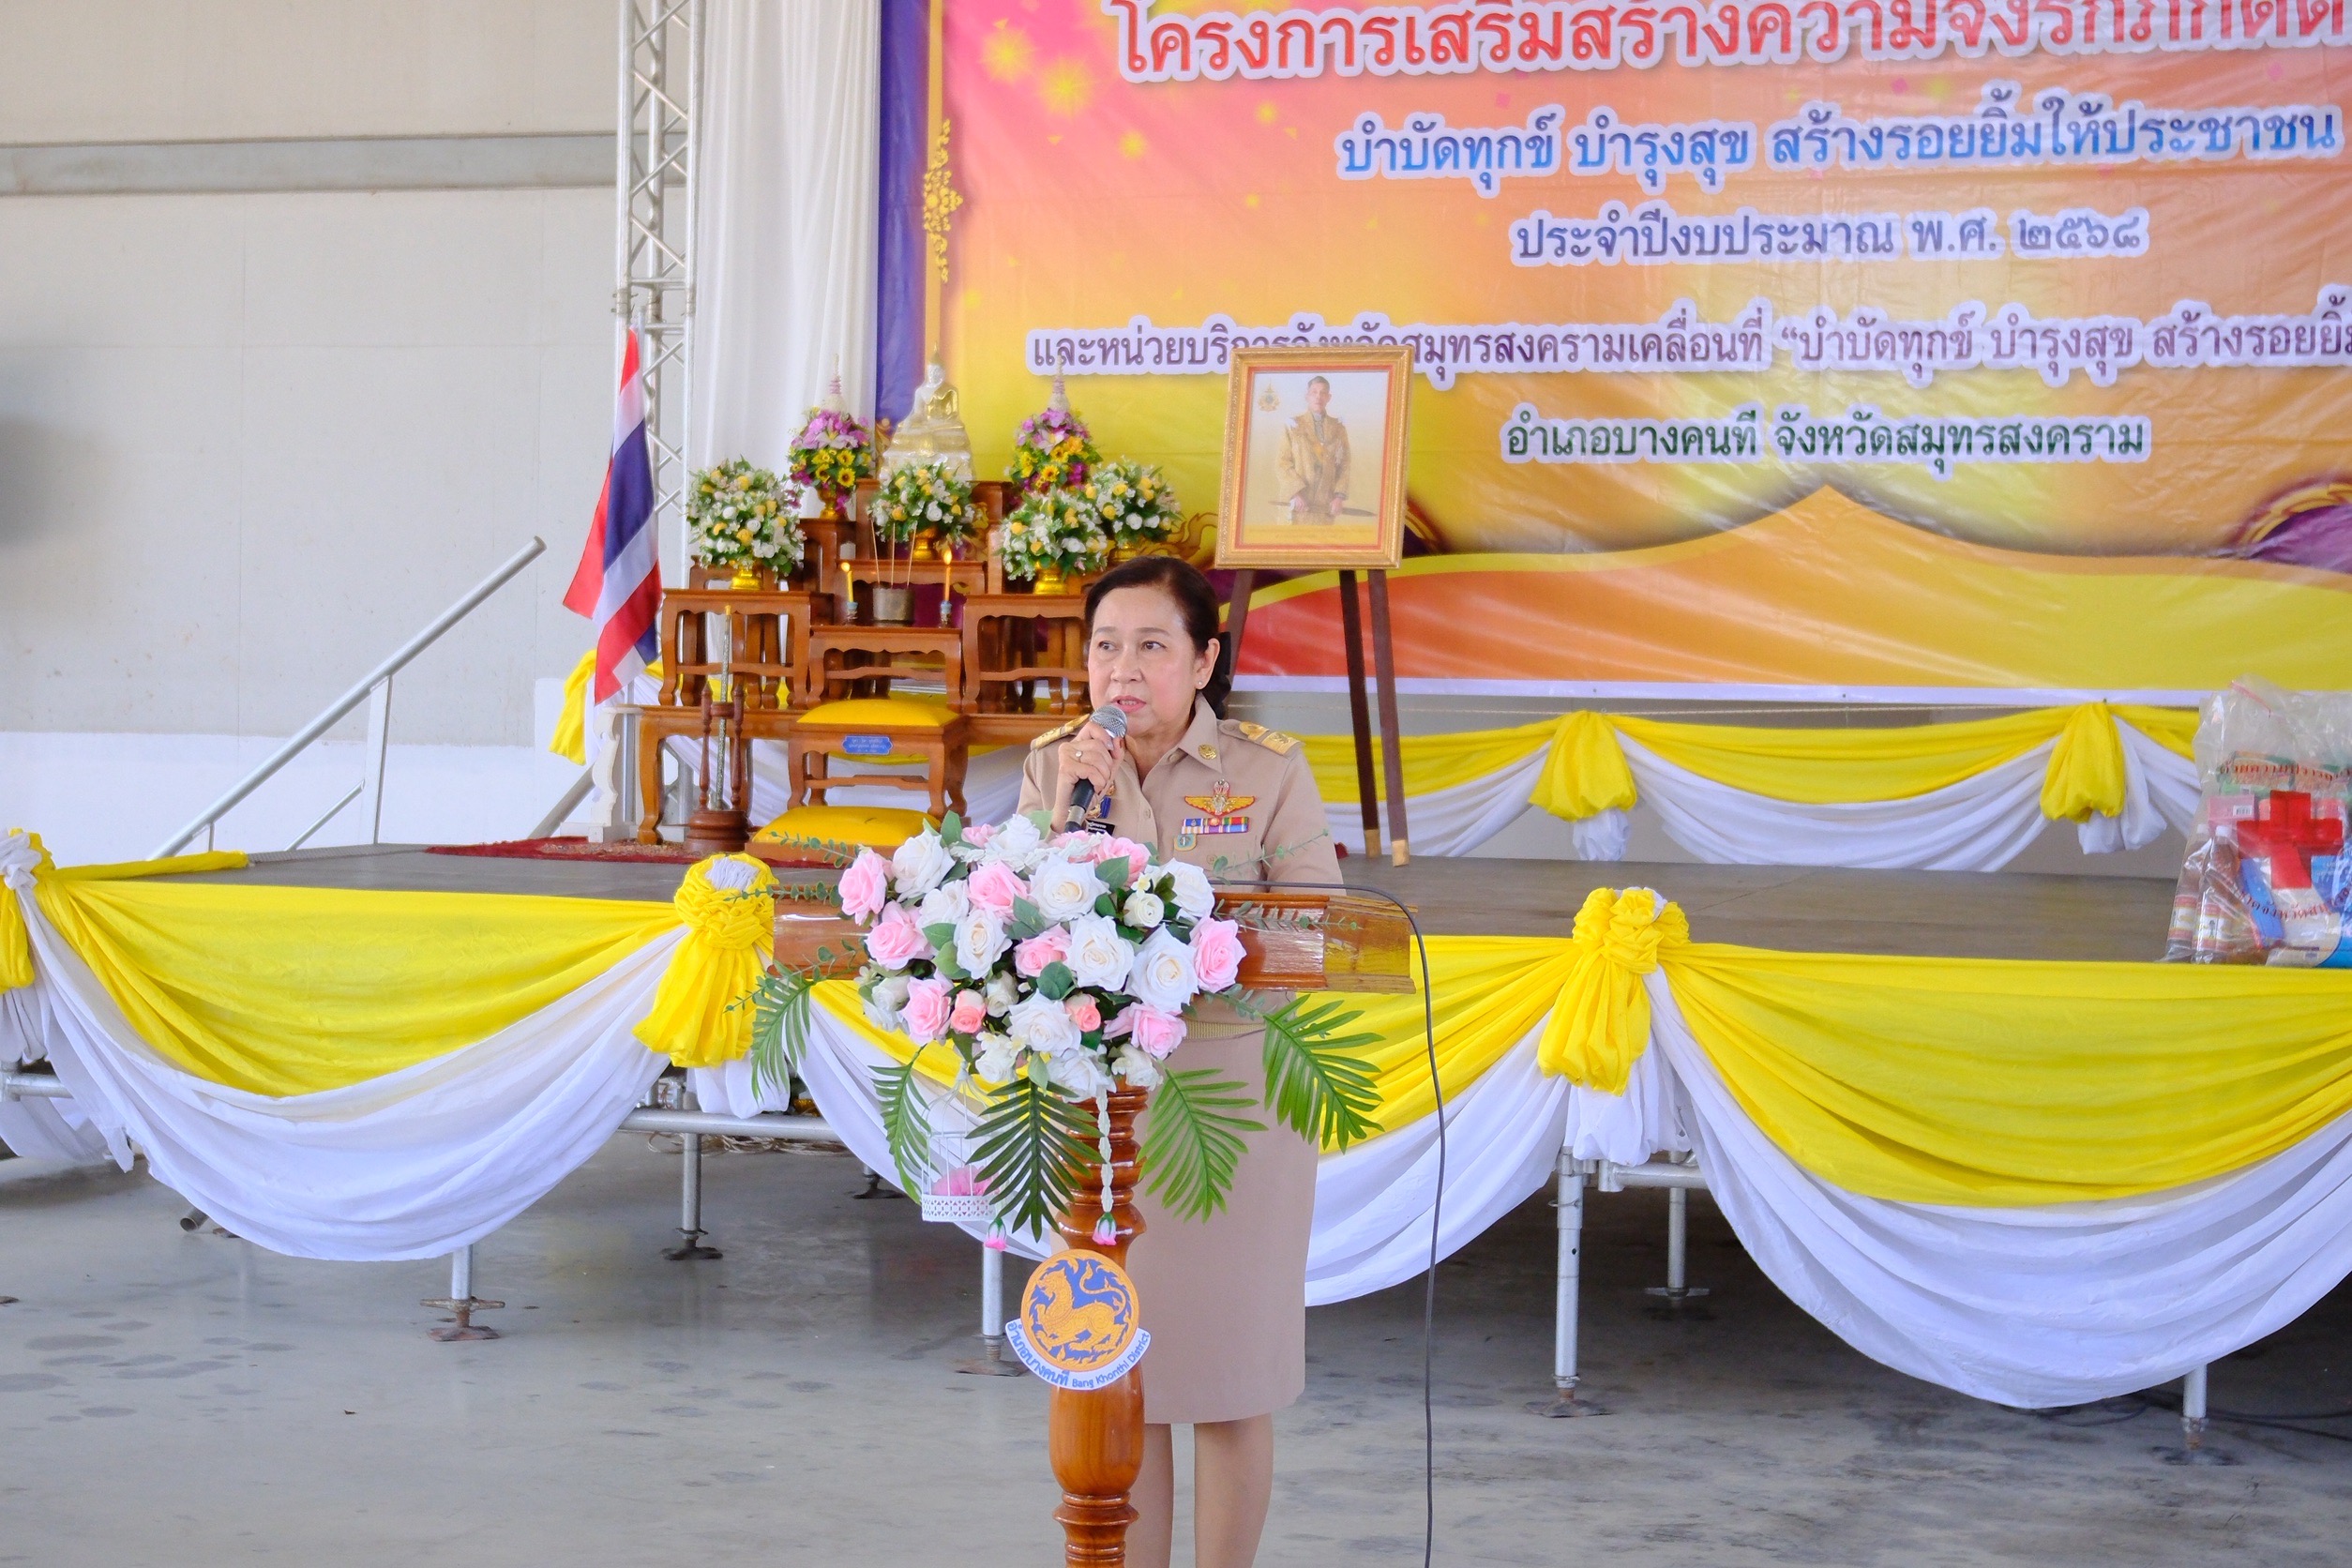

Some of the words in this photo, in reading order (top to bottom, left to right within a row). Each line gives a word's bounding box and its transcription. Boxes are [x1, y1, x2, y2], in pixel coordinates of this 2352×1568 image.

[1342, 113, 1558, 190] บำบัดทุกข์
[1576, 114, 1749, 186] บำรุงสุข
[1772, 87, 2335, 165] สร้างรอยยิ้มให้ประชาชน
[1516, 208, 1894, 258] ประจำปีงบประมาณ
[1911, 217, 1997, 252] พ.ศ.
[2017, 215, 2143, 250] ๒๕๖๘
[1782, 312, 1974, 376] “บำบัดทุกข์
[1991, 313, 2134, 378] บำรุงสุข
[1507, 410, 1756, 456] อำเภอบางคนที
[1773, 411, 2143, 475] จังหวัดสมุทรสงคราม
[1072, 1379, 1094, 1389] Bang
[1095, 1361, 1130, 1385] Khonthi
[1128, 1333, 1150, 1364] District
